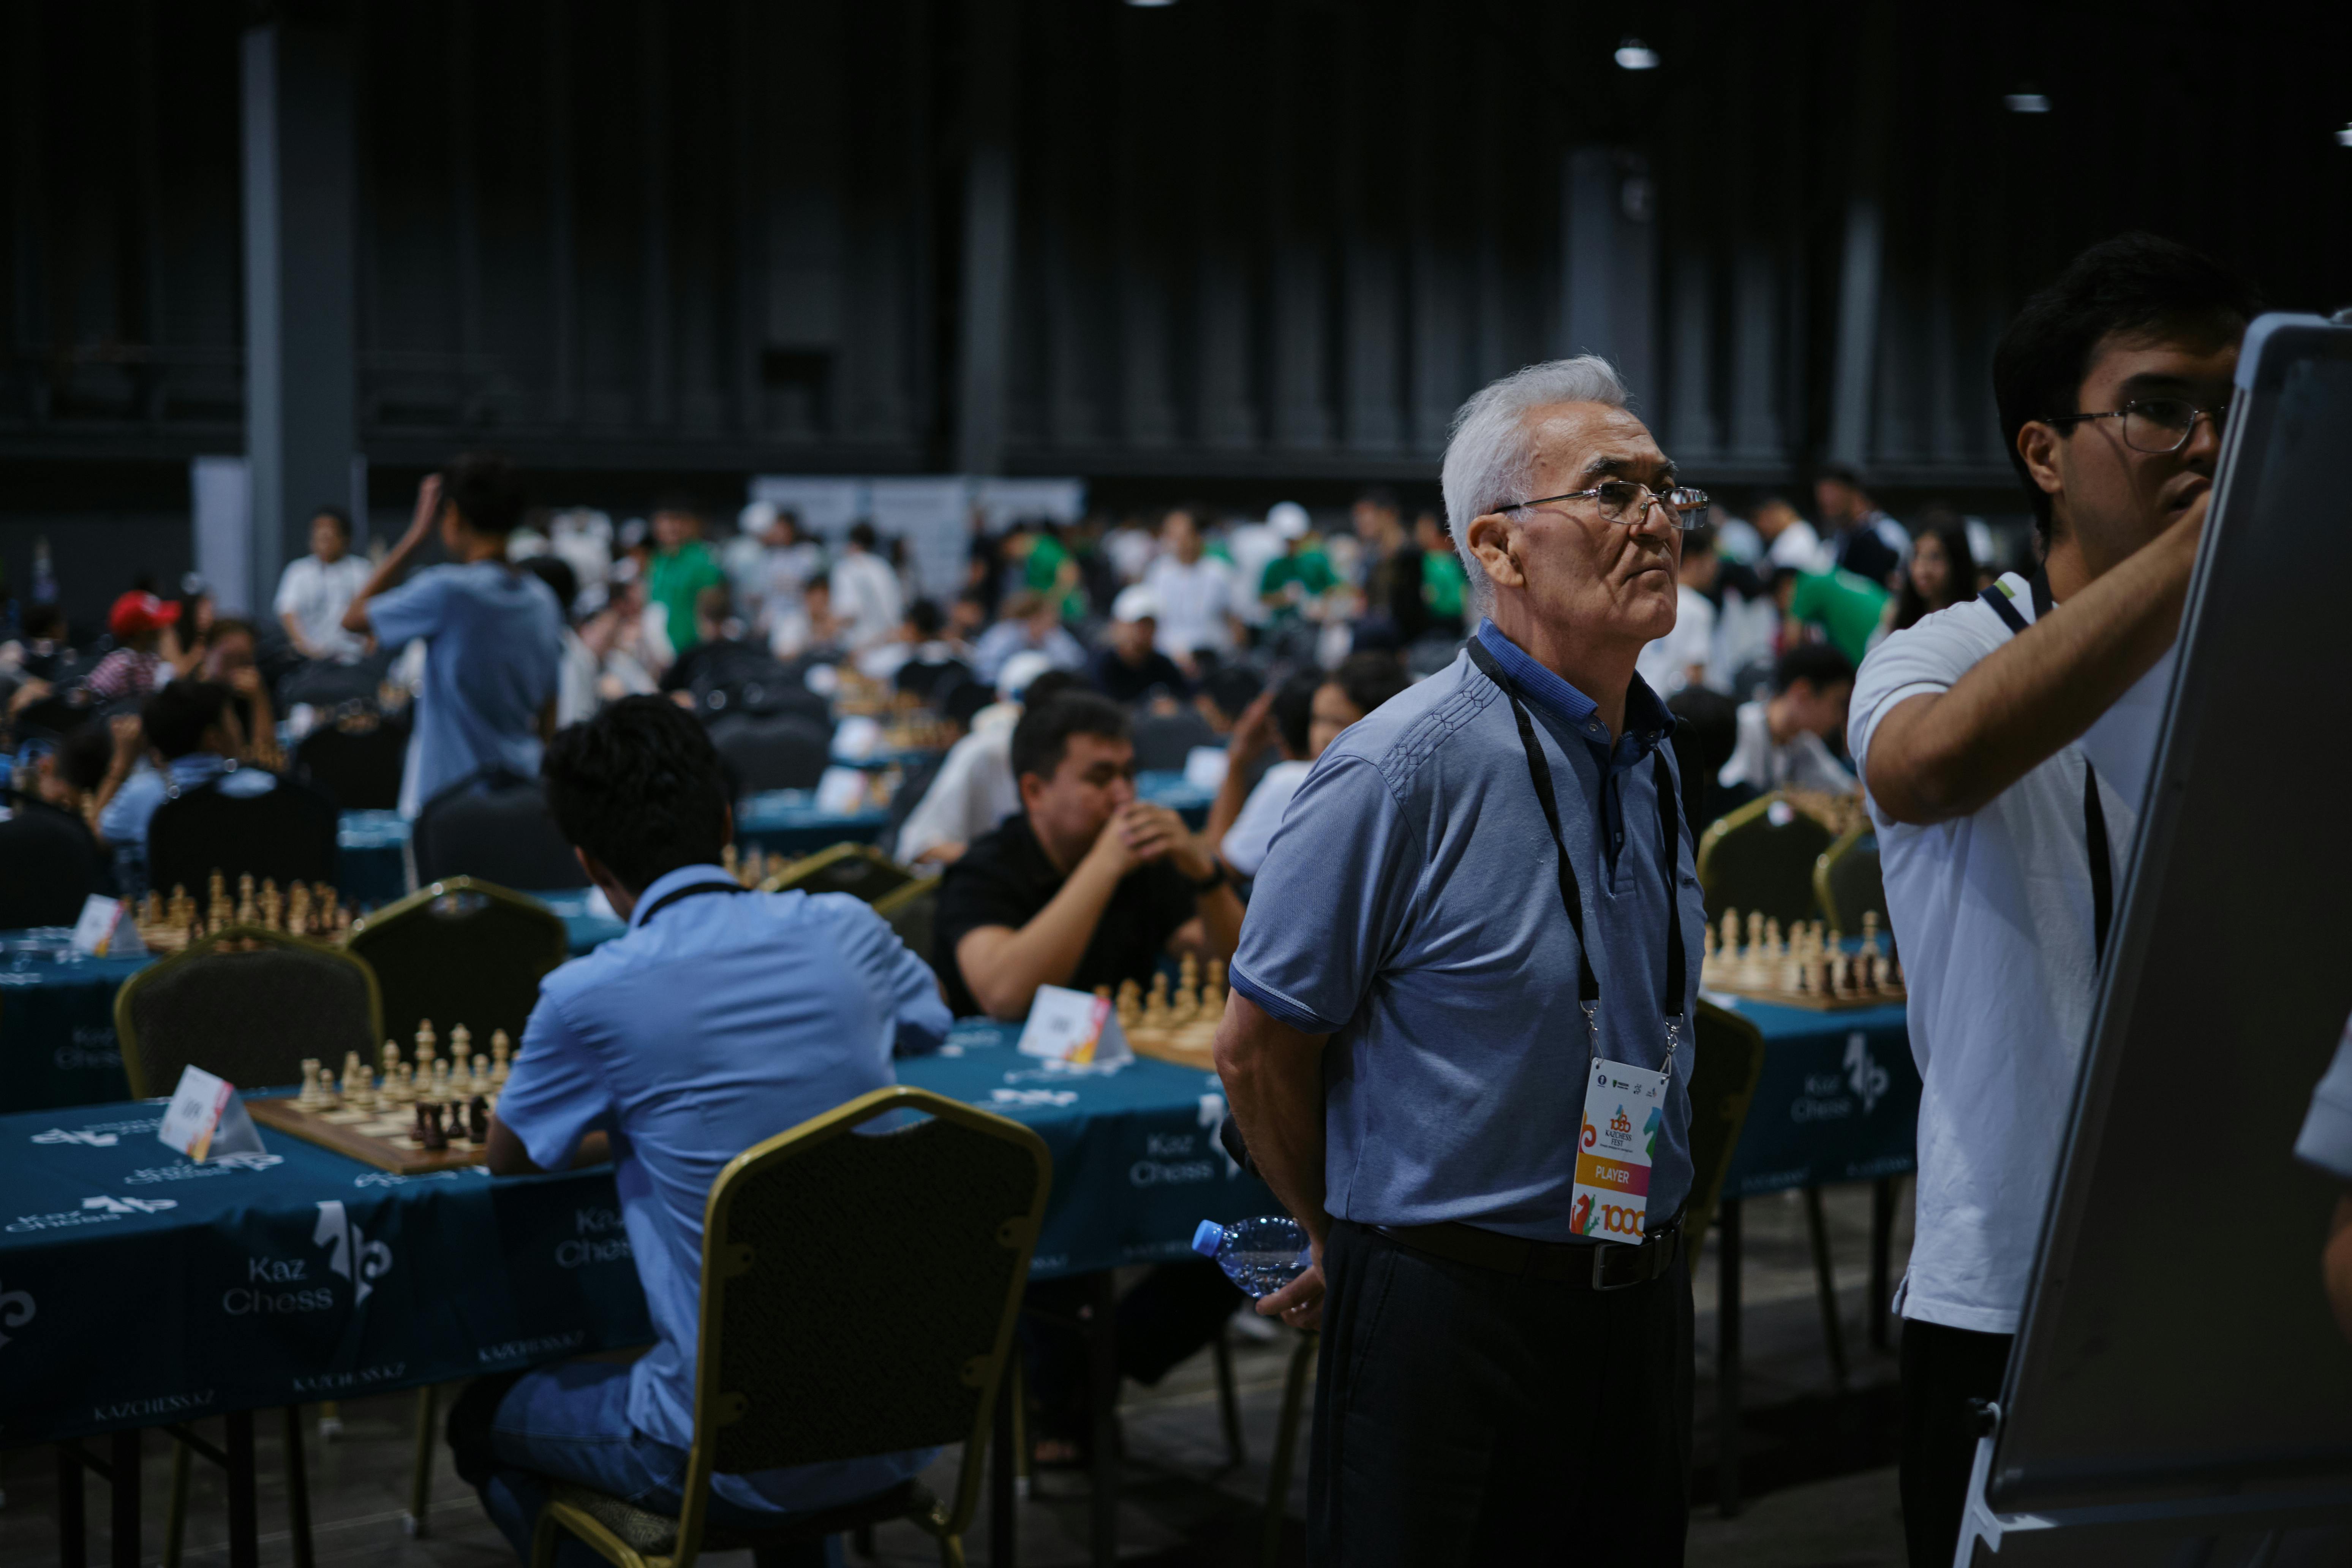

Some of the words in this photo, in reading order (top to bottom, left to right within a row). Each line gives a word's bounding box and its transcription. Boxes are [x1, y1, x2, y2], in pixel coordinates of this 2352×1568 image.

[1605, 1130, 1632, 1141] KAZCHESS
[1611, 1138, 1624, 1147] FEST
[1595, 1165, 1630, 1184] PLAYER
[555, 1237, 632, 1269] Ches
[249, 1256, 308, 1283] Kaz
[223, 1287, 334, 1315] Chess
